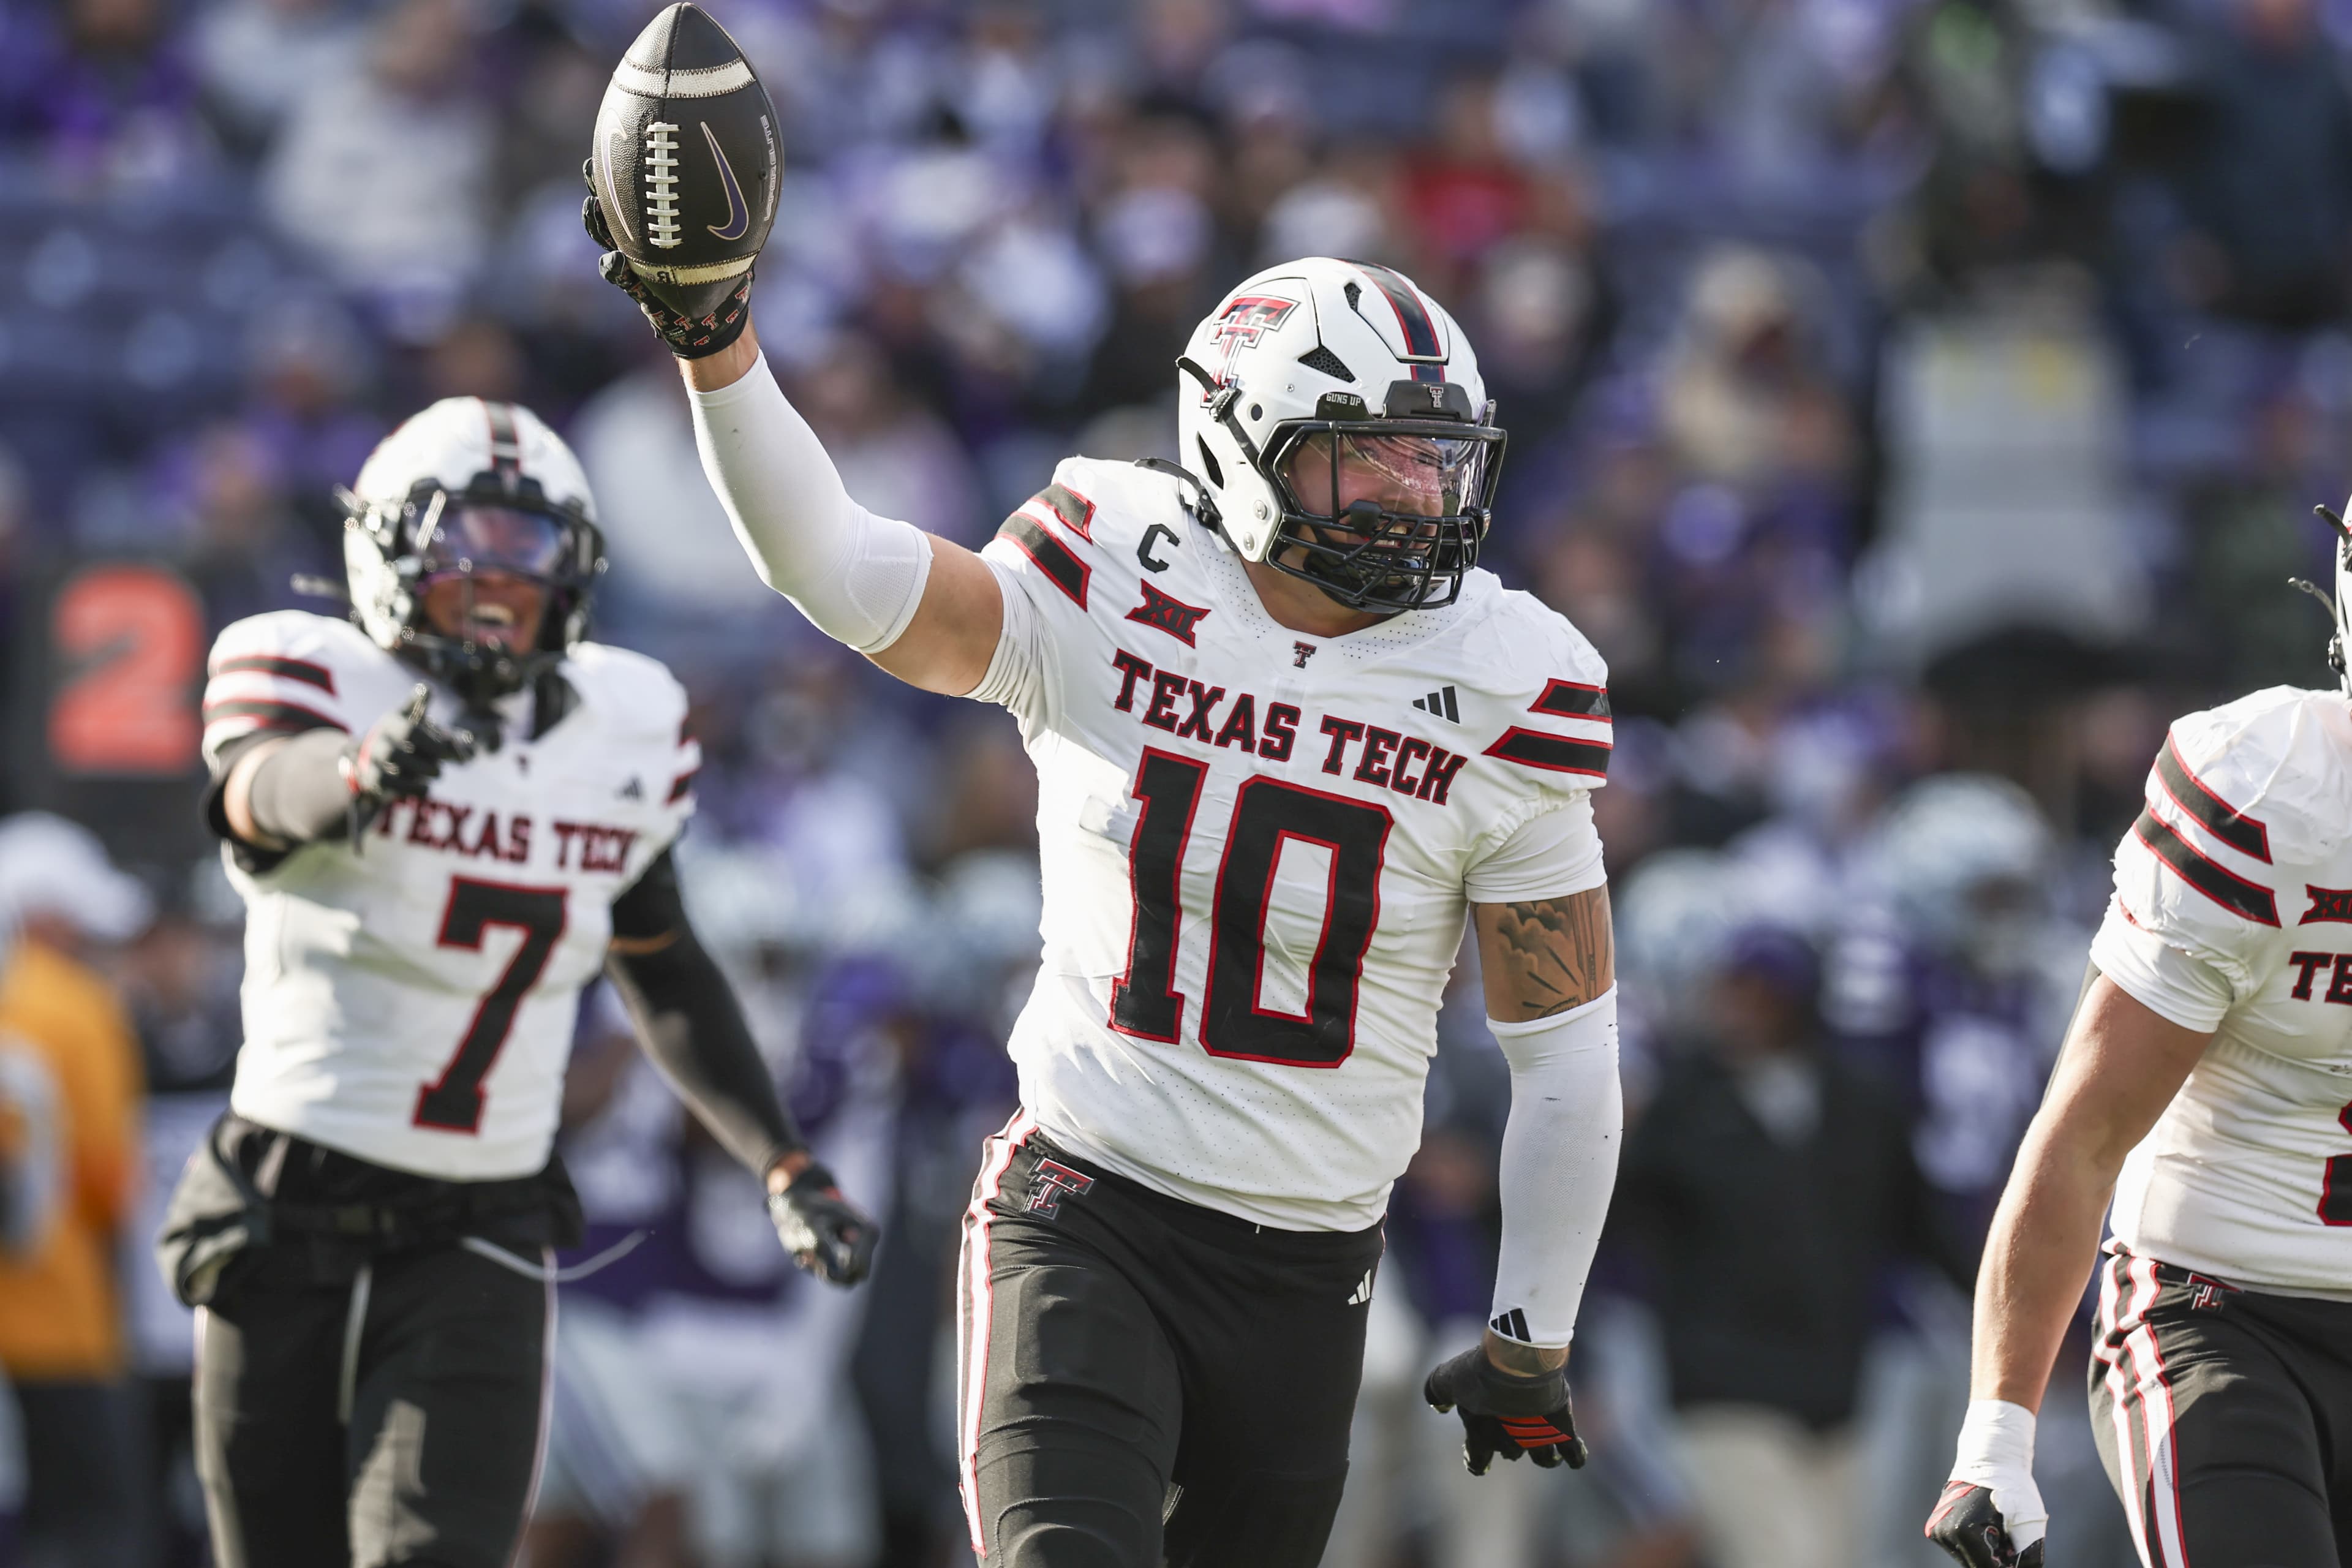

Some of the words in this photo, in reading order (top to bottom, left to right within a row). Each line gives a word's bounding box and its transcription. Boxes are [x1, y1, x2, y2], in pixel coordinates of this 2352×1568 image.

[760, 115, 776, 165] ELITE
[764, 165, 777, 221] VAPOR
[1326, 392, 1348, 405] GUNS
[1349, 396, 1362, 406] UP
[1136, 523, 1180, 573] C
[50, 565, 203, 774] 2
[1112, 648, 1302, 762] TEXAS
[1319, 714, 1468, 806] TECH
[377, 795, 532, 865] TEXAS
[552, 820, 639, 874] TE
[1107, 745, 1395, 1069] 10
[412, 872, 570, 1136] 7
